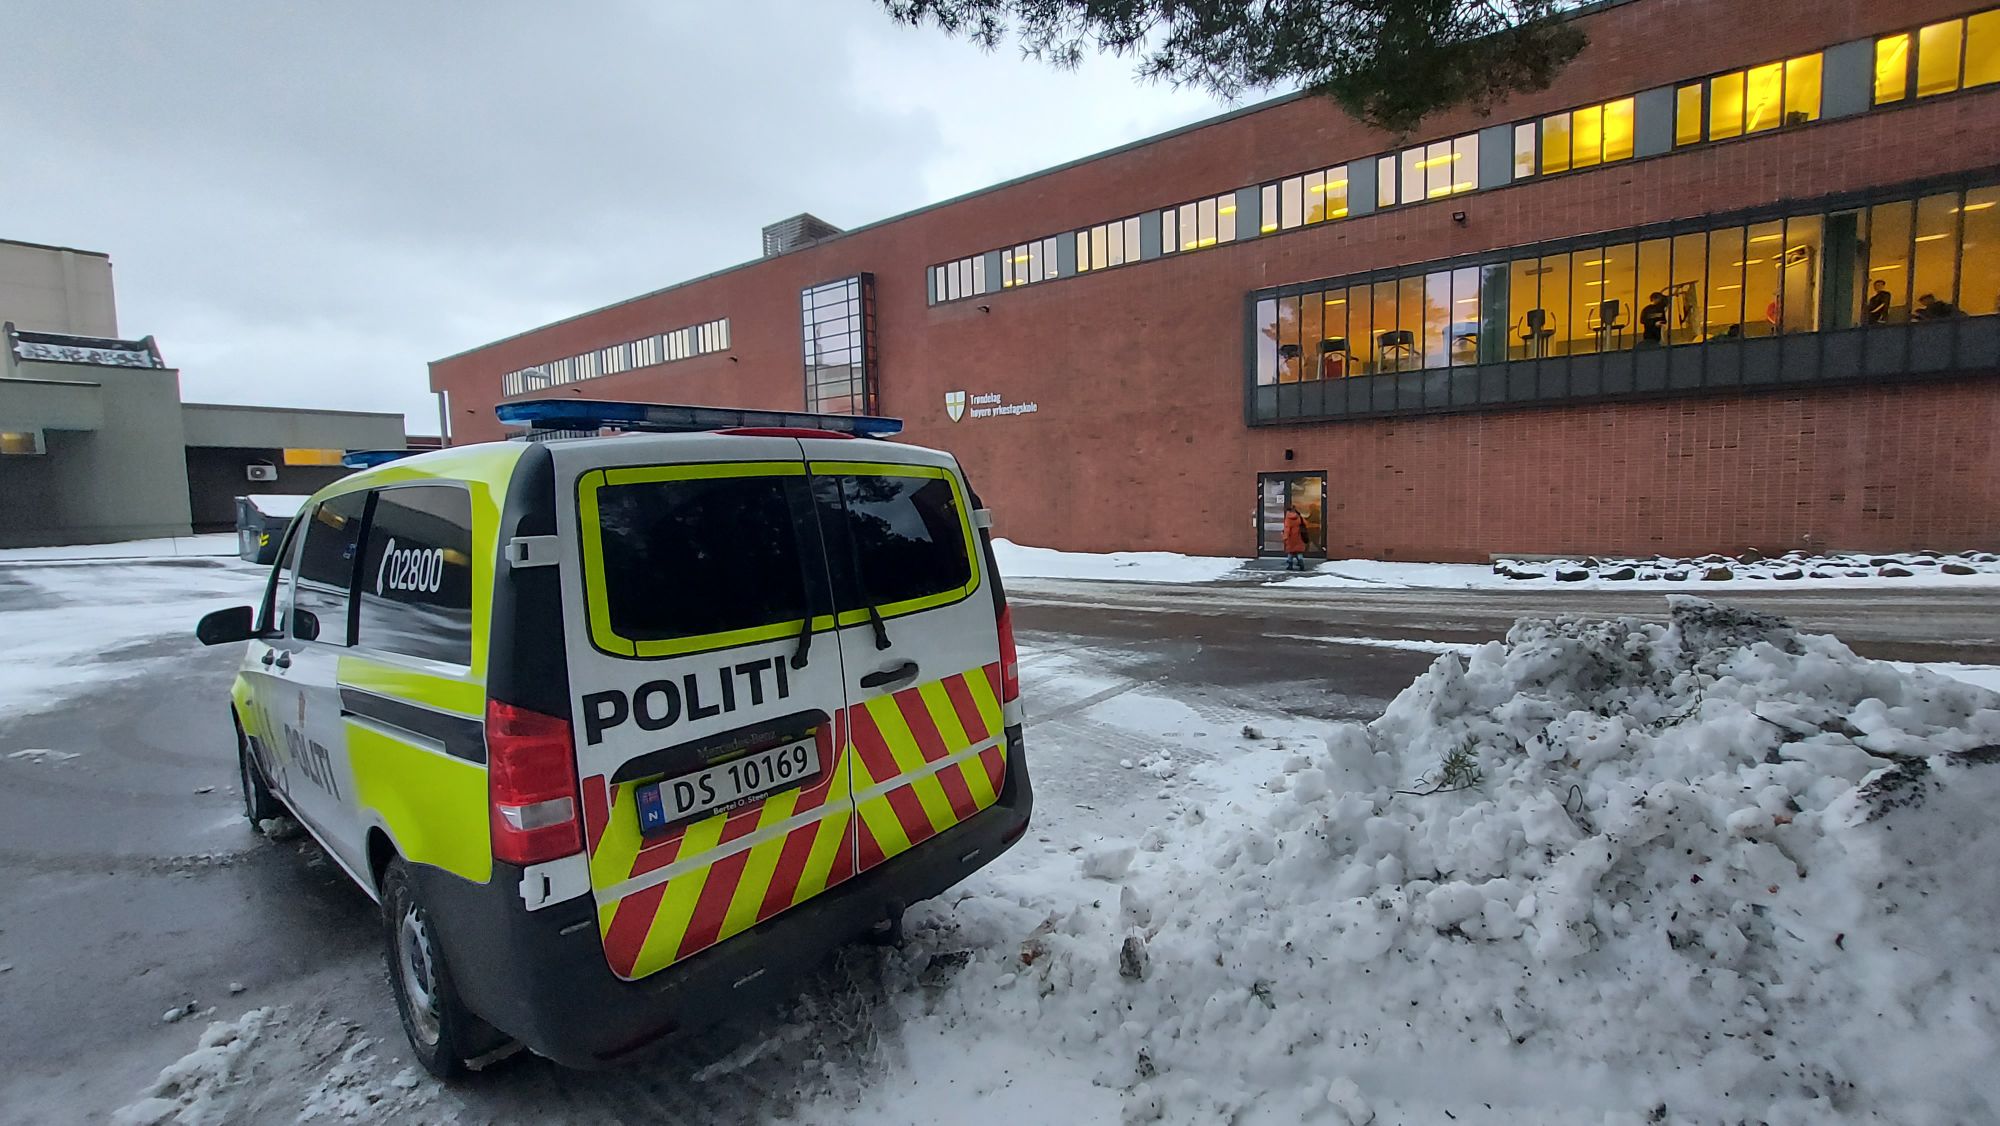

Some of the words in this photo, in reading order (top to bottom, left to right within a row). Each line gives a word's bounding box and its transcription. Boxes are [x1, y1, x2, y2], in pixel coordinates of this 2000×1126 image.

[389, 547, 444, 593] 02800
[581, 655, 790, 746] POLITI
[675, 774, 716, 812] DS
[727, 745, 808, 794] 10169
[648, 811, 659, 822] N
[713, 801, 737, 815] Bertel
[747, 792, 769, 803] Steen
